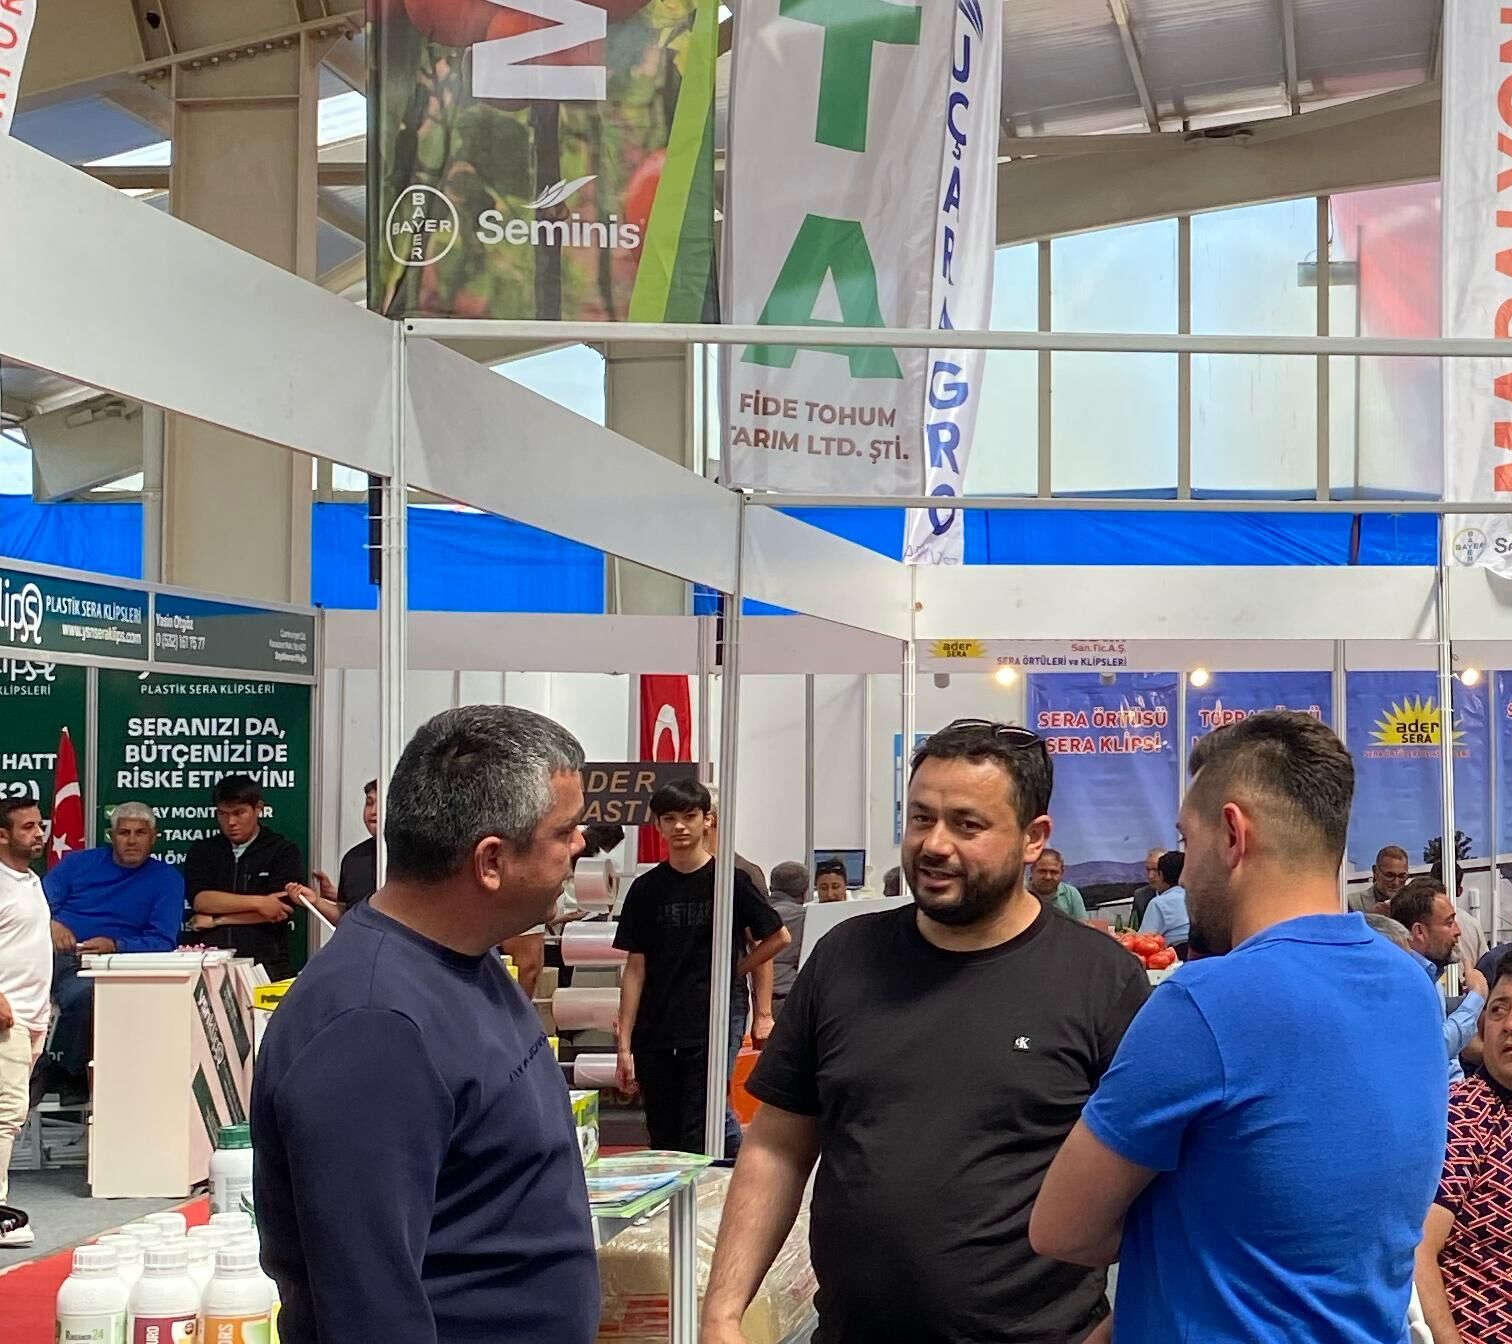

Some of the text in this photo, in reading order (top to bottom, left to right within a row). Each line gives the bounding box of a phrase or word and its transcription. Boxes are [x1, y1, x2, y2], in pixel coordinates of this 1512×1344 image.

[391, 219, 452, 236] BAYER
[476, 209, 641, 250] Seminis
[739, 390, 897, 428] FİDE TOHUM
[807, 434, 863, 457] LTD.
[869, 435, 910, 465] ŞTİ.
[81, 600, 102, 619] SERA
[997, 657, 1020, 666] SERA
[1022, 655, 1067, 666] ÖRTÜLERİ
[1081, 656, 1127, 667] KLİPSLERİ
[141, 682, 276, 695] PLASTİK SERA KLİPSLERİ
[128, 717, 286, 740] SERANIZI DA,
[1038, 709, 1089, 729] SERA
[1396, 719, 1440, 734] ader
[1046, 736, 1093, 755] SERA
[1401, 734, 1433, 744] SERA
[125, 739, 288, 769] BÜTÇENİZİ DE
[117, 766, 183, 788] RİSKE
[580, 770, 656, 793] DER
